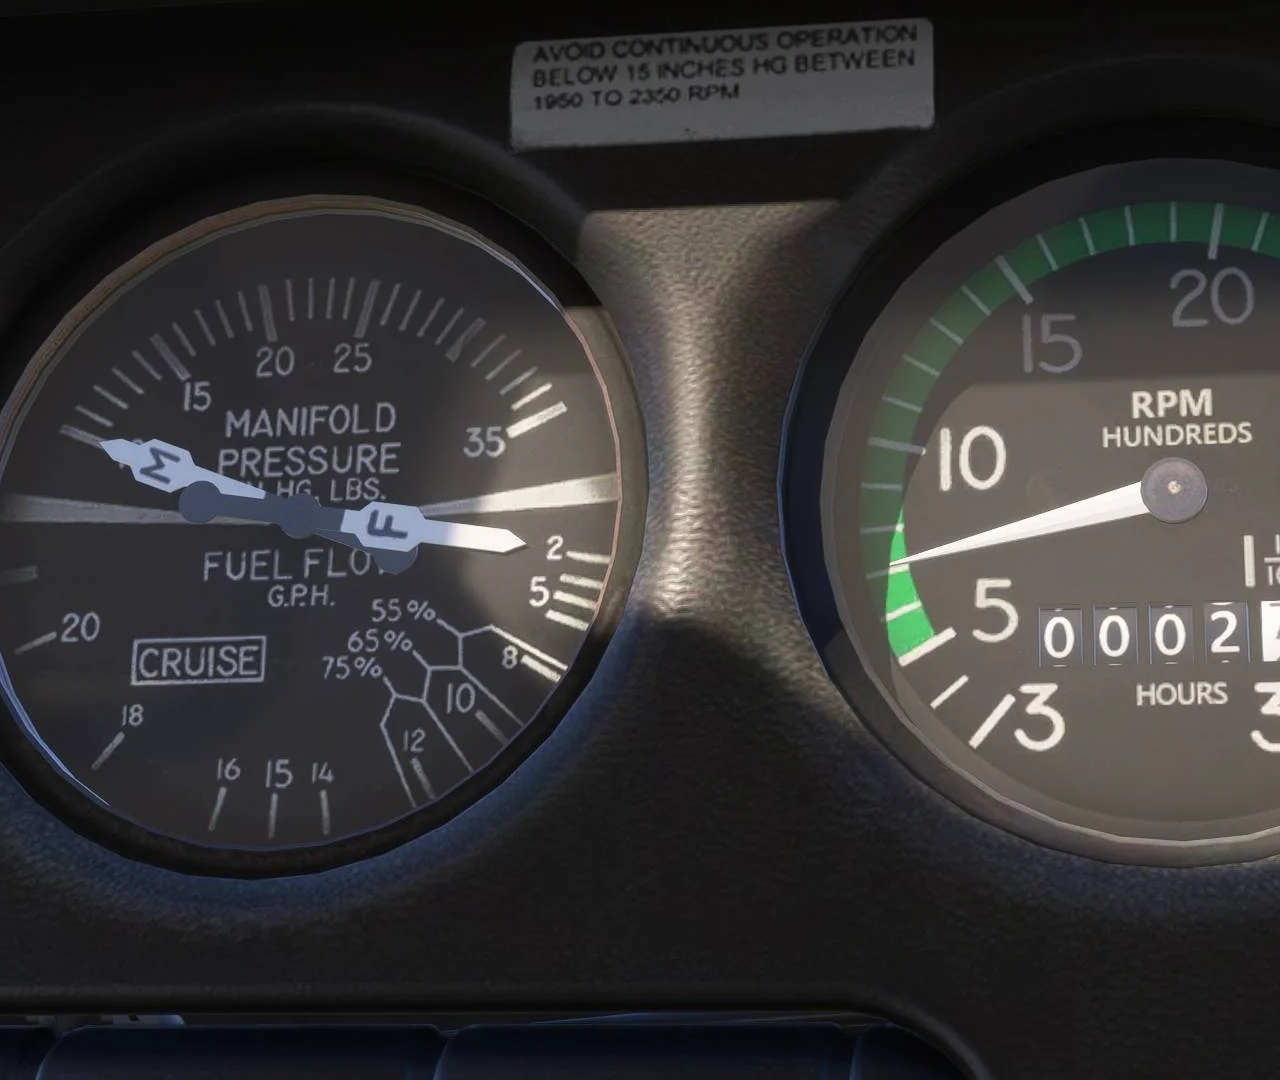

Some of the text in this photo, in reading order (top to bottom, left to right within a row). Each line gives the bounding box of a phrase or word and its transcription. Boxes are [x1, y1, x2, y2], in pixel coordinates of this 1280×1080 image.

[532, 25, 918, 64] AVOID CONTINUOUS OPERATION
[533, 48, 916, 88] BELOW 15 INCHES HG BETWEEN
[533, 92, 583, 111] 1950
[592, 89, 623, 107] TO
[688, 83, 740, 102] RPM
[1169, 266, 1255, 327] 20
[334, 343, 373, 375] 25
[1022, 314, 1083, 373] 15
[255, 346, 296, 378] 20
[183, 382, 212, 413] 15
[1131, 388, 1214, 420] RPM
[225, 402, 397, 439] MANIFOLD
[1102, 421, 1254, 449] HUNDREDS
[463, 427, 508, 458] 35
[218, 442, 402, 478] PRESSURE
[939, 426, 1007, 492] 10
[545, 536, 564, 560] 2
[203, 549, 292, 582] FUEL
[528, 576, 550, 607] 5
[370, 598, 437, 622] 55%
[971, 578, 1019, 643] 5
[60, 612, 101, 643] 20
[347, 630, 414, 654] 65%
[138, 644, 261, 679] CRUISE
[321, 656, 384, 680] 75%
[501, 645, 518, 670] 8
[444, 682, 476, 715] 10
[1135, 681, 1229, 707] HOURS
[121, 703, 145, 727] 18
[1014, 682, 1067, 752] 3
[401, 728, 426, 754] 12
[217, 757, 243, 782] 16
[266, 757, 295, 787] 15
[311, 760, 335, 784] 14
